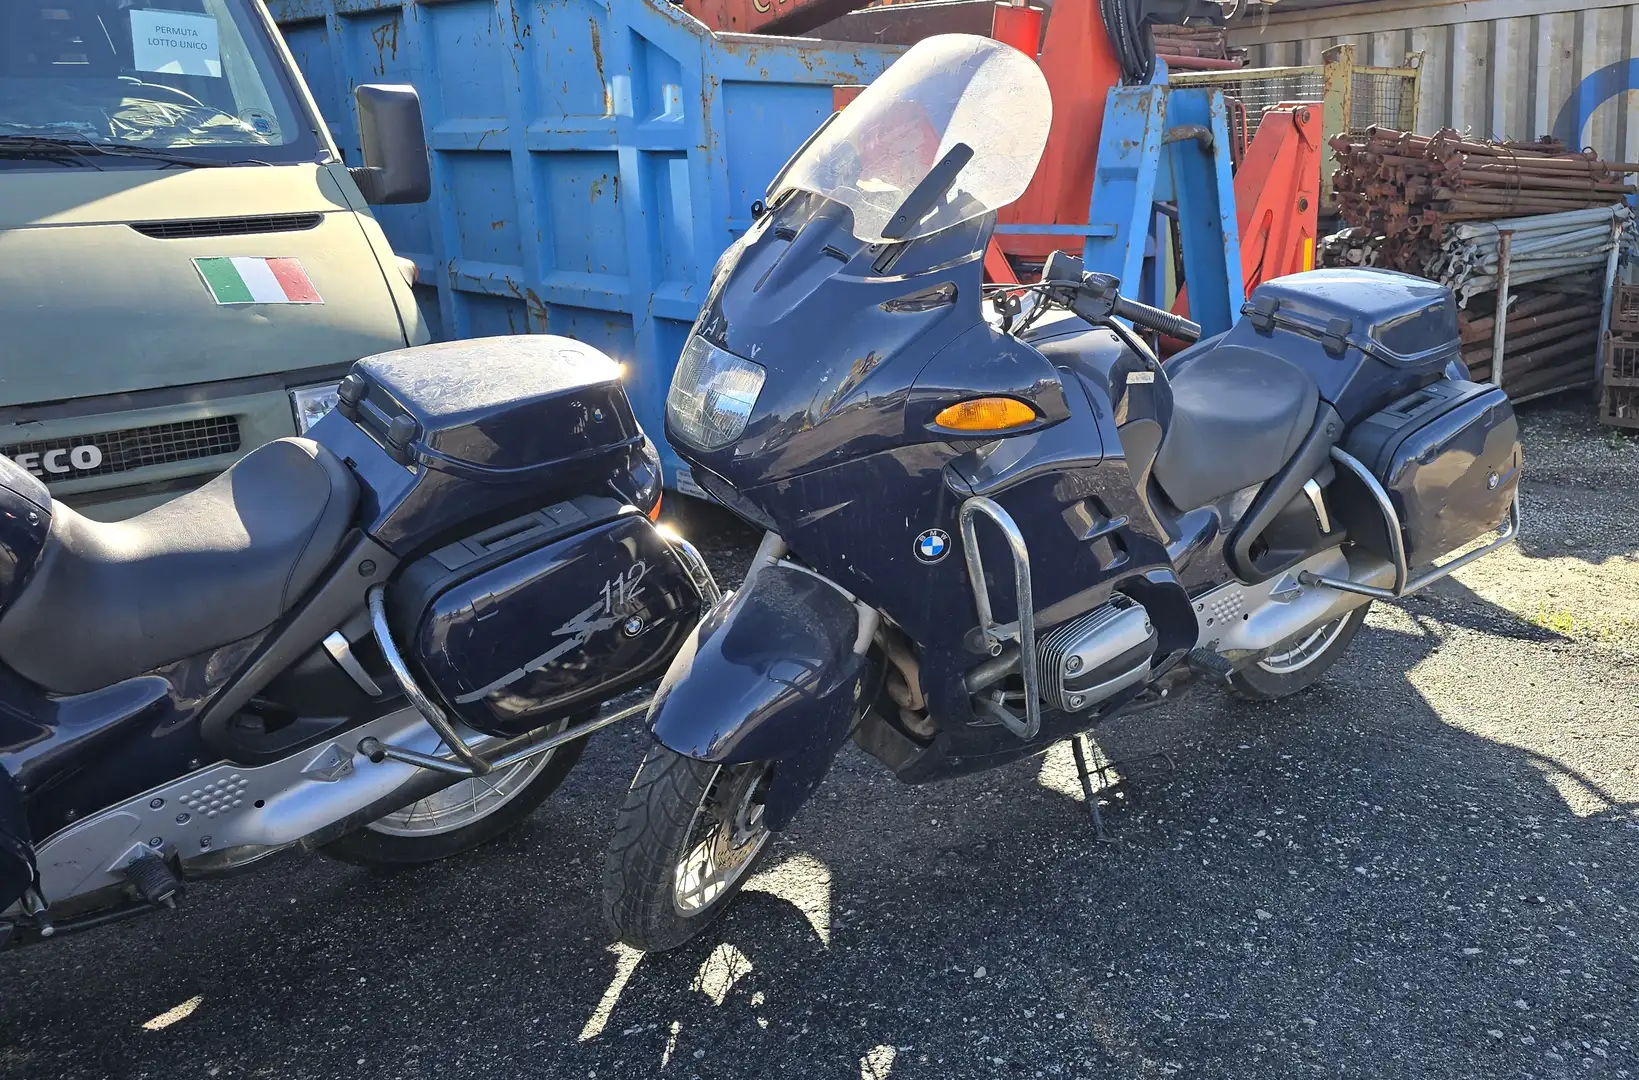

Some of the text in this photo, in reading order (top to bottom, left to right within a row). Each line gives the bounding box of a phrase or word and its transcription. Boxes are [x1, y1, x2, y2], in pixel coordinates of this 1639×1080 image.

[155, 25, 198, 37] PERMUTA
[147, 37, 208, 51] LOTTO UNICO
[8, 444, 103, 476] ECO
[918, 530, 948, 542] BMW
[599, 560, 647, 614] 112
